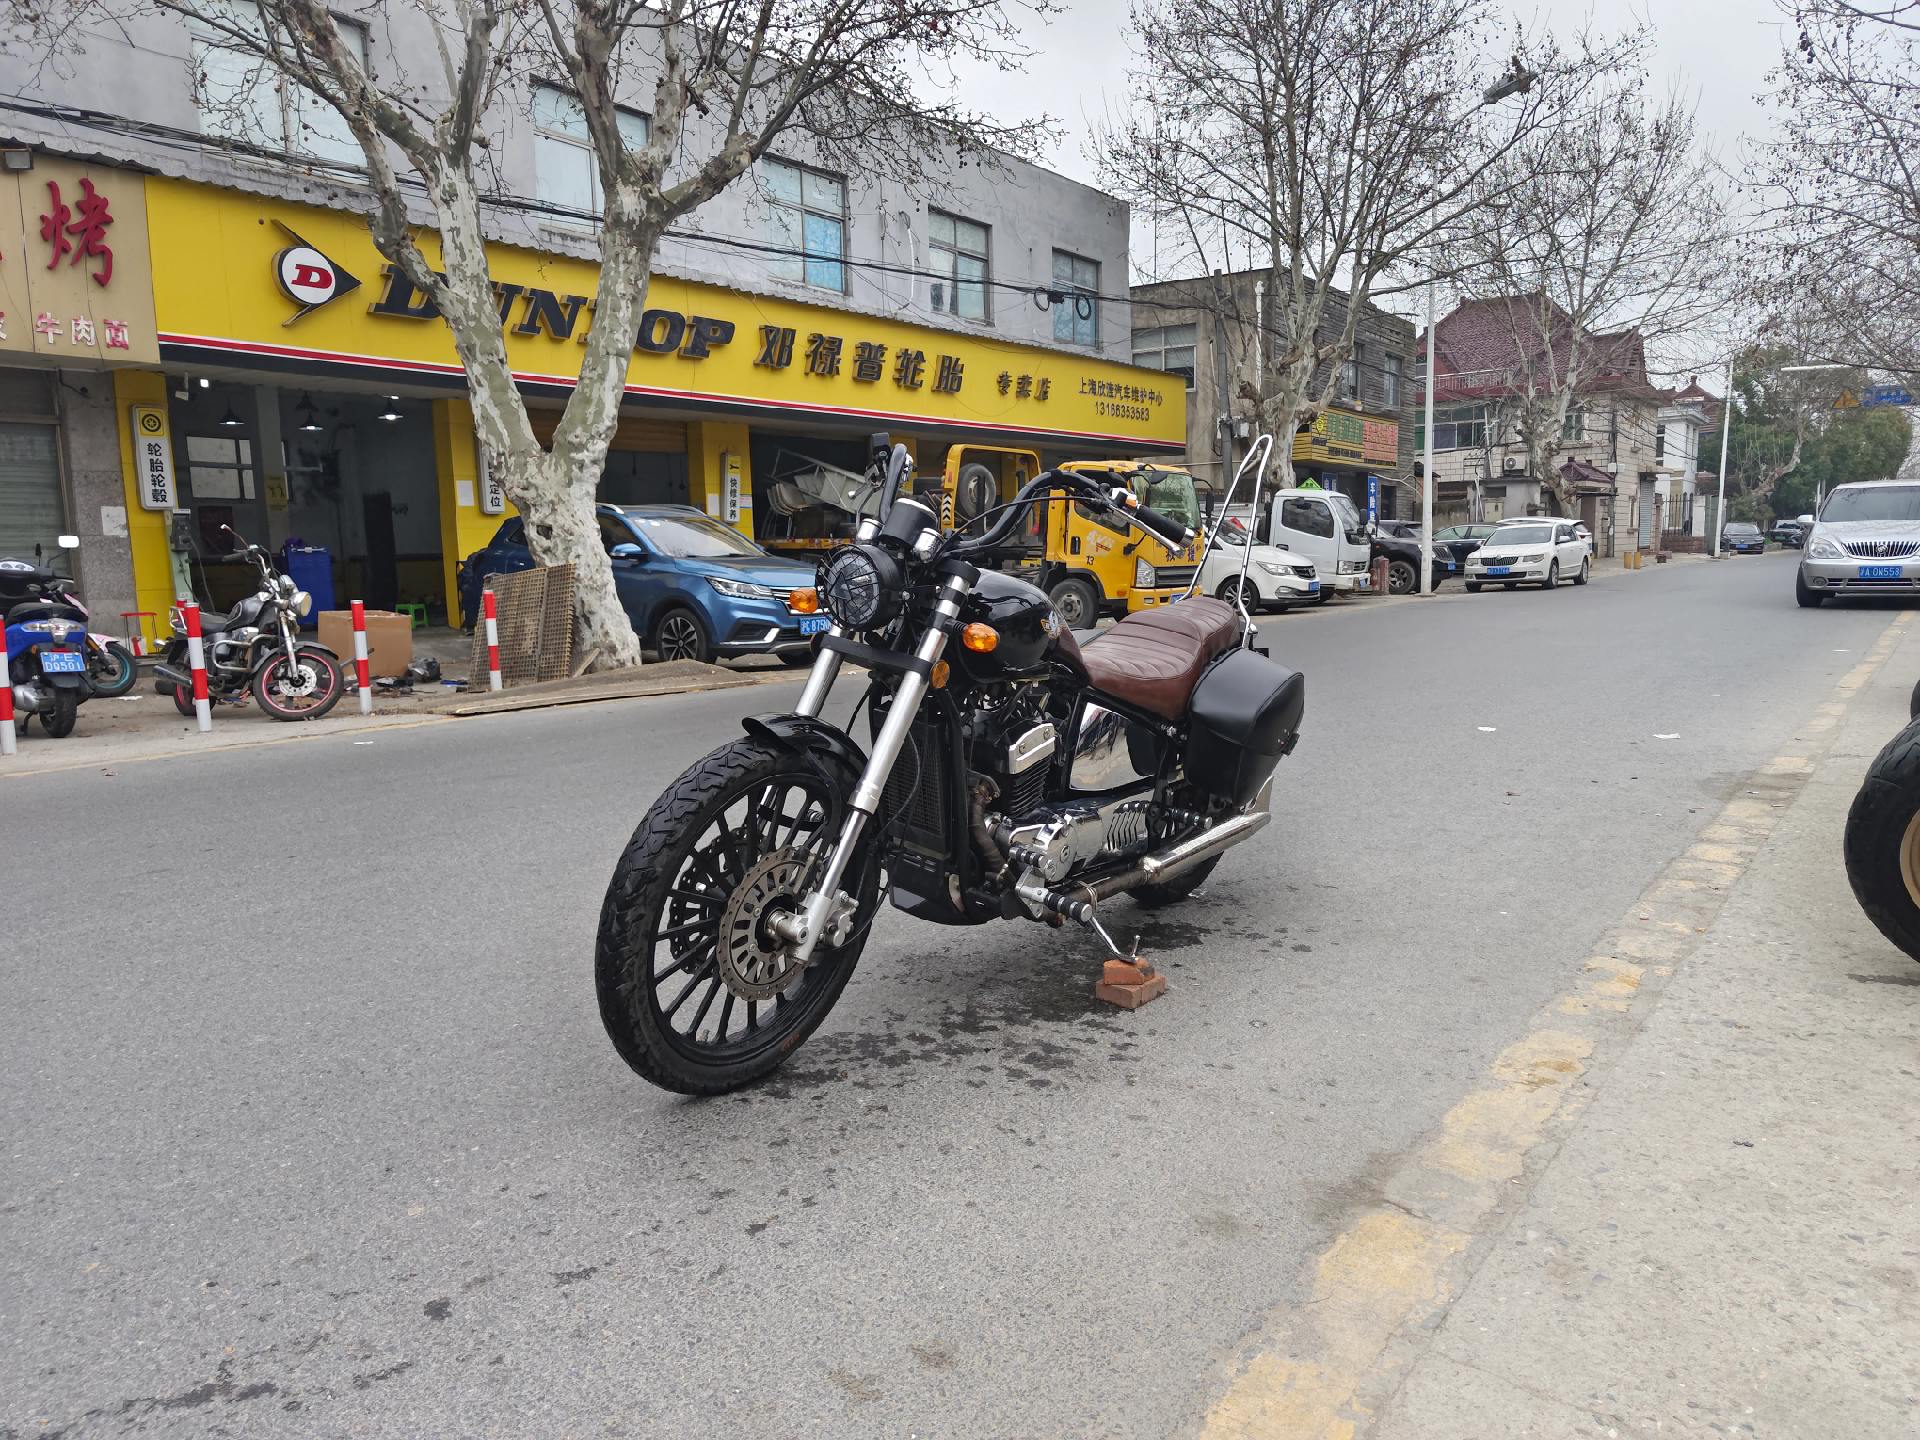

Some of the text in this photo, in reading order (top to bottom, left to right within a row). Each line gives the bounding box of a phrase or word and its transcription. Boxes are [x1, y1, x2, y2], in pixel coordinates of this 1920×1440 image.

[40, 177, 114, 287] 烤
[291, 264, 334, 290] D
[368, 264, 736, 358] DNOP
[36, 311, 129, 350] 牛肉面
[753, 325, 965, 393] 邓禄普轮胎
